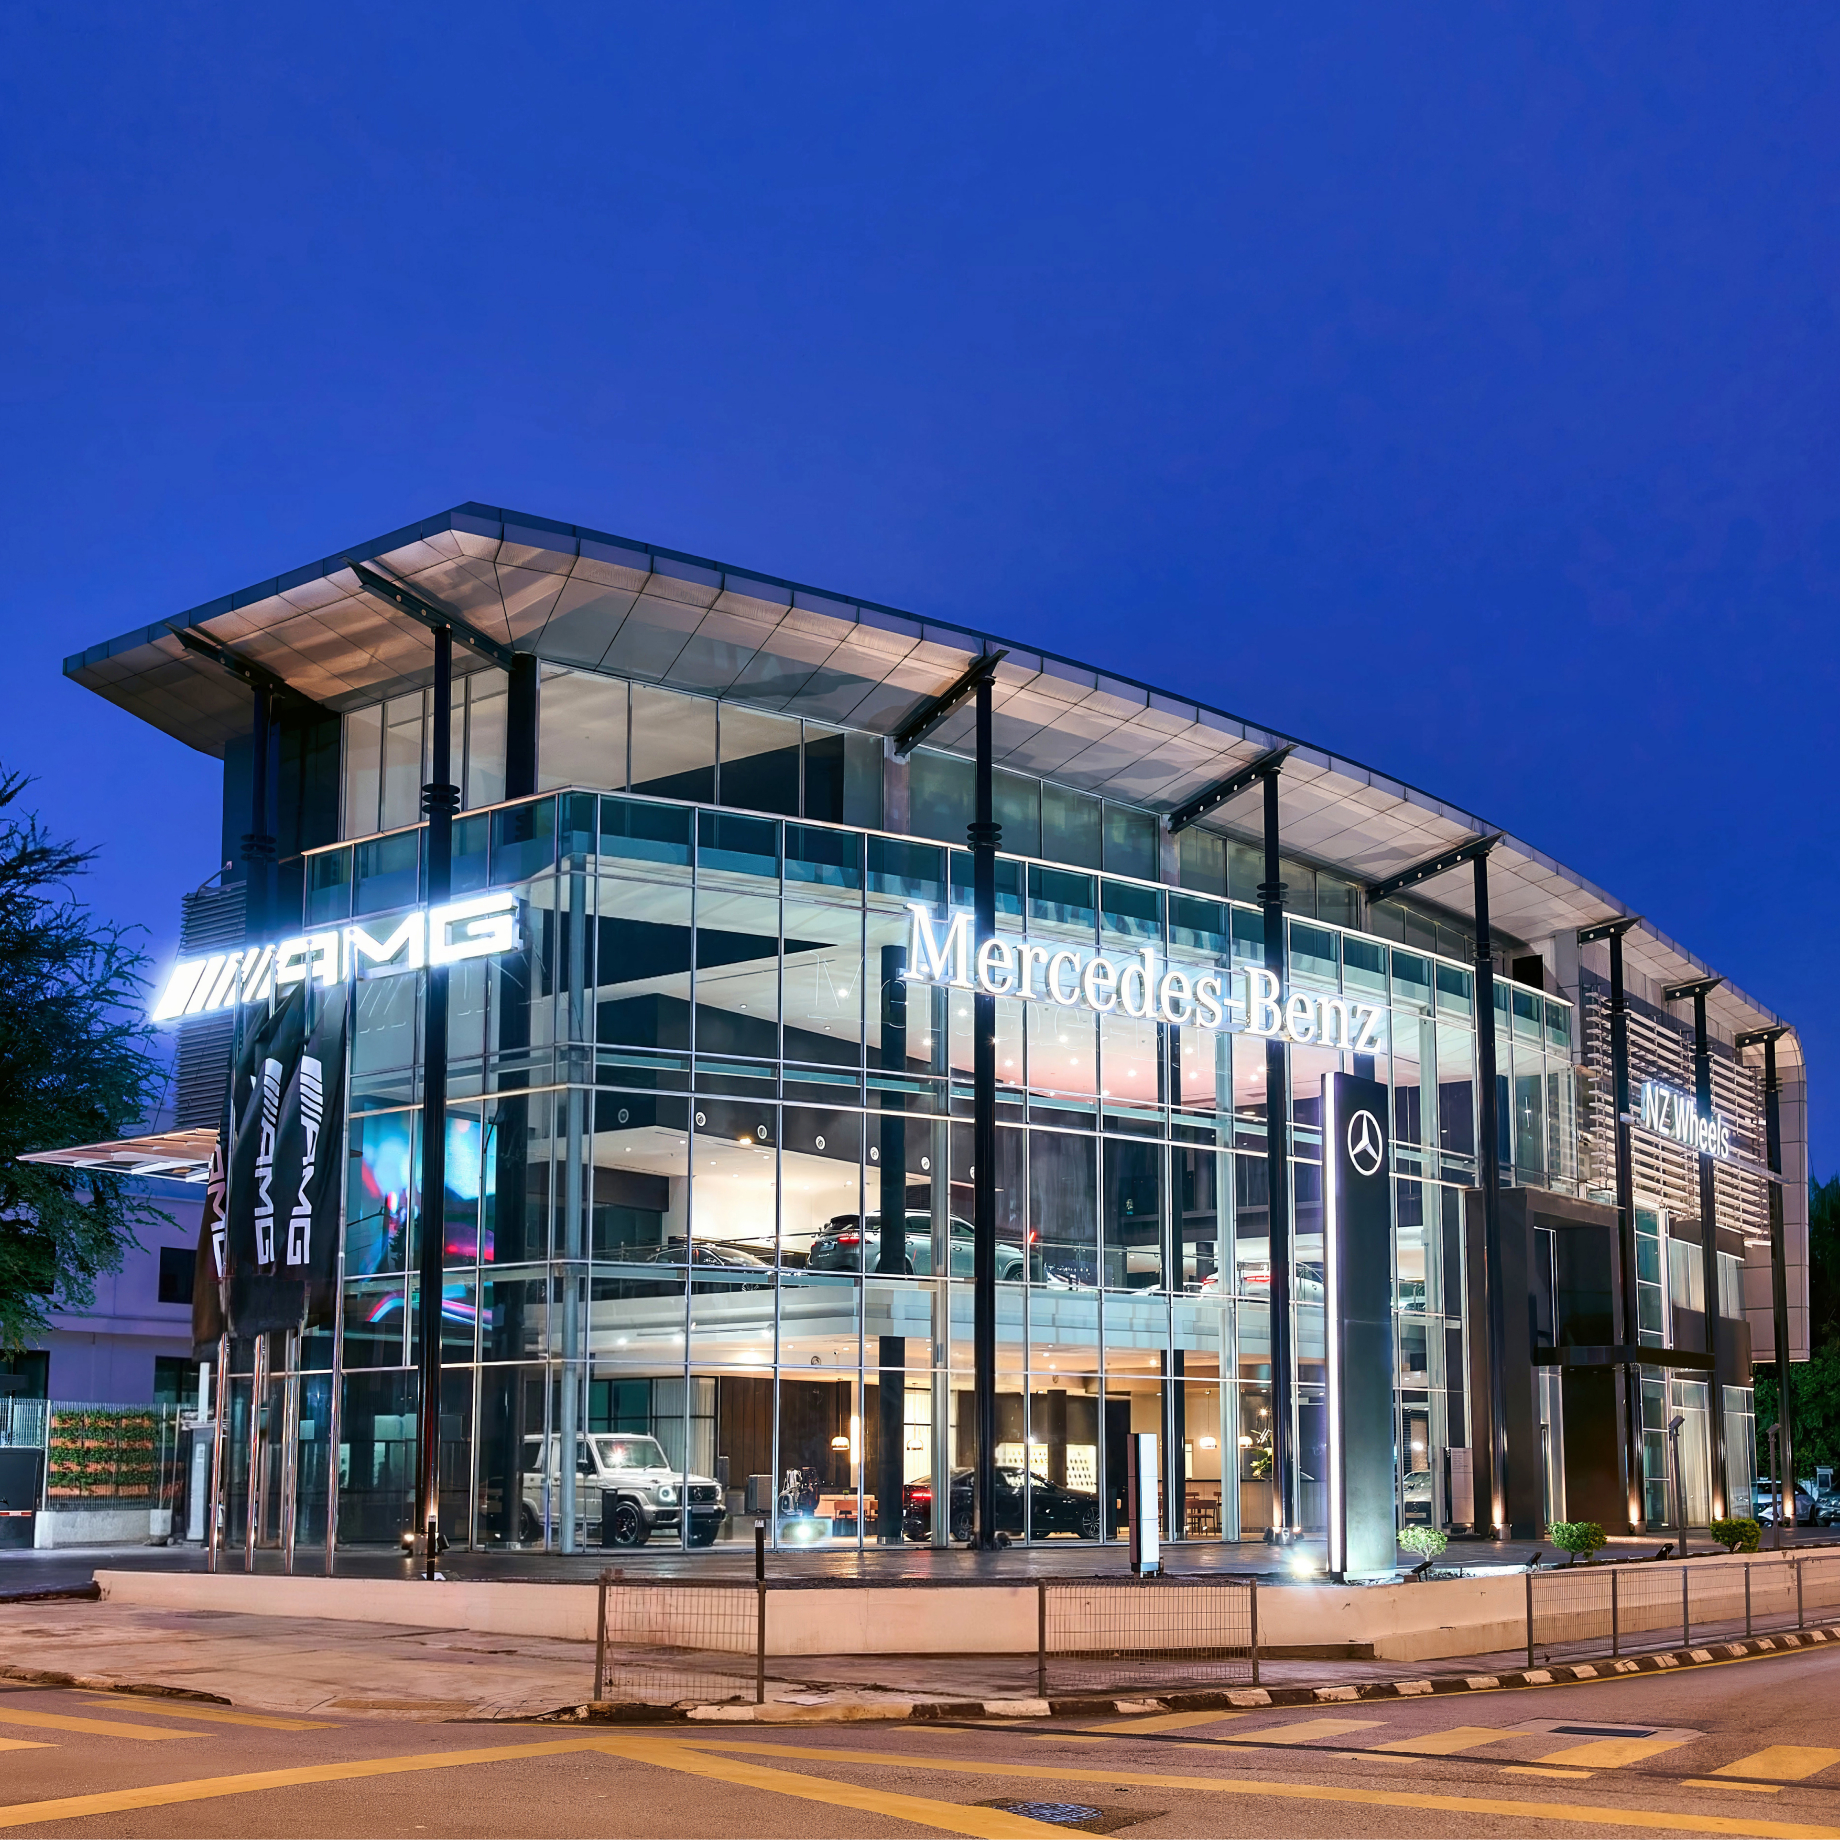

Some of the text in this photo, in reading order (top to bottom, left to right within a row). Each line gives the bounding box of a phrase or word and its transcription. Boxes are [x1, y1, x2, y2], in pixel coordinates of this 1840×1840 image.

[273, 892, 515, 988] AMG
[902, 901, 1383, 1055] Mercedes-Benz
[254, 1116, 276, 1265] AMG
[286, 1111, 321, 1266] AMG
[1645, 1081, 1729, 1159] NZ Wheels
